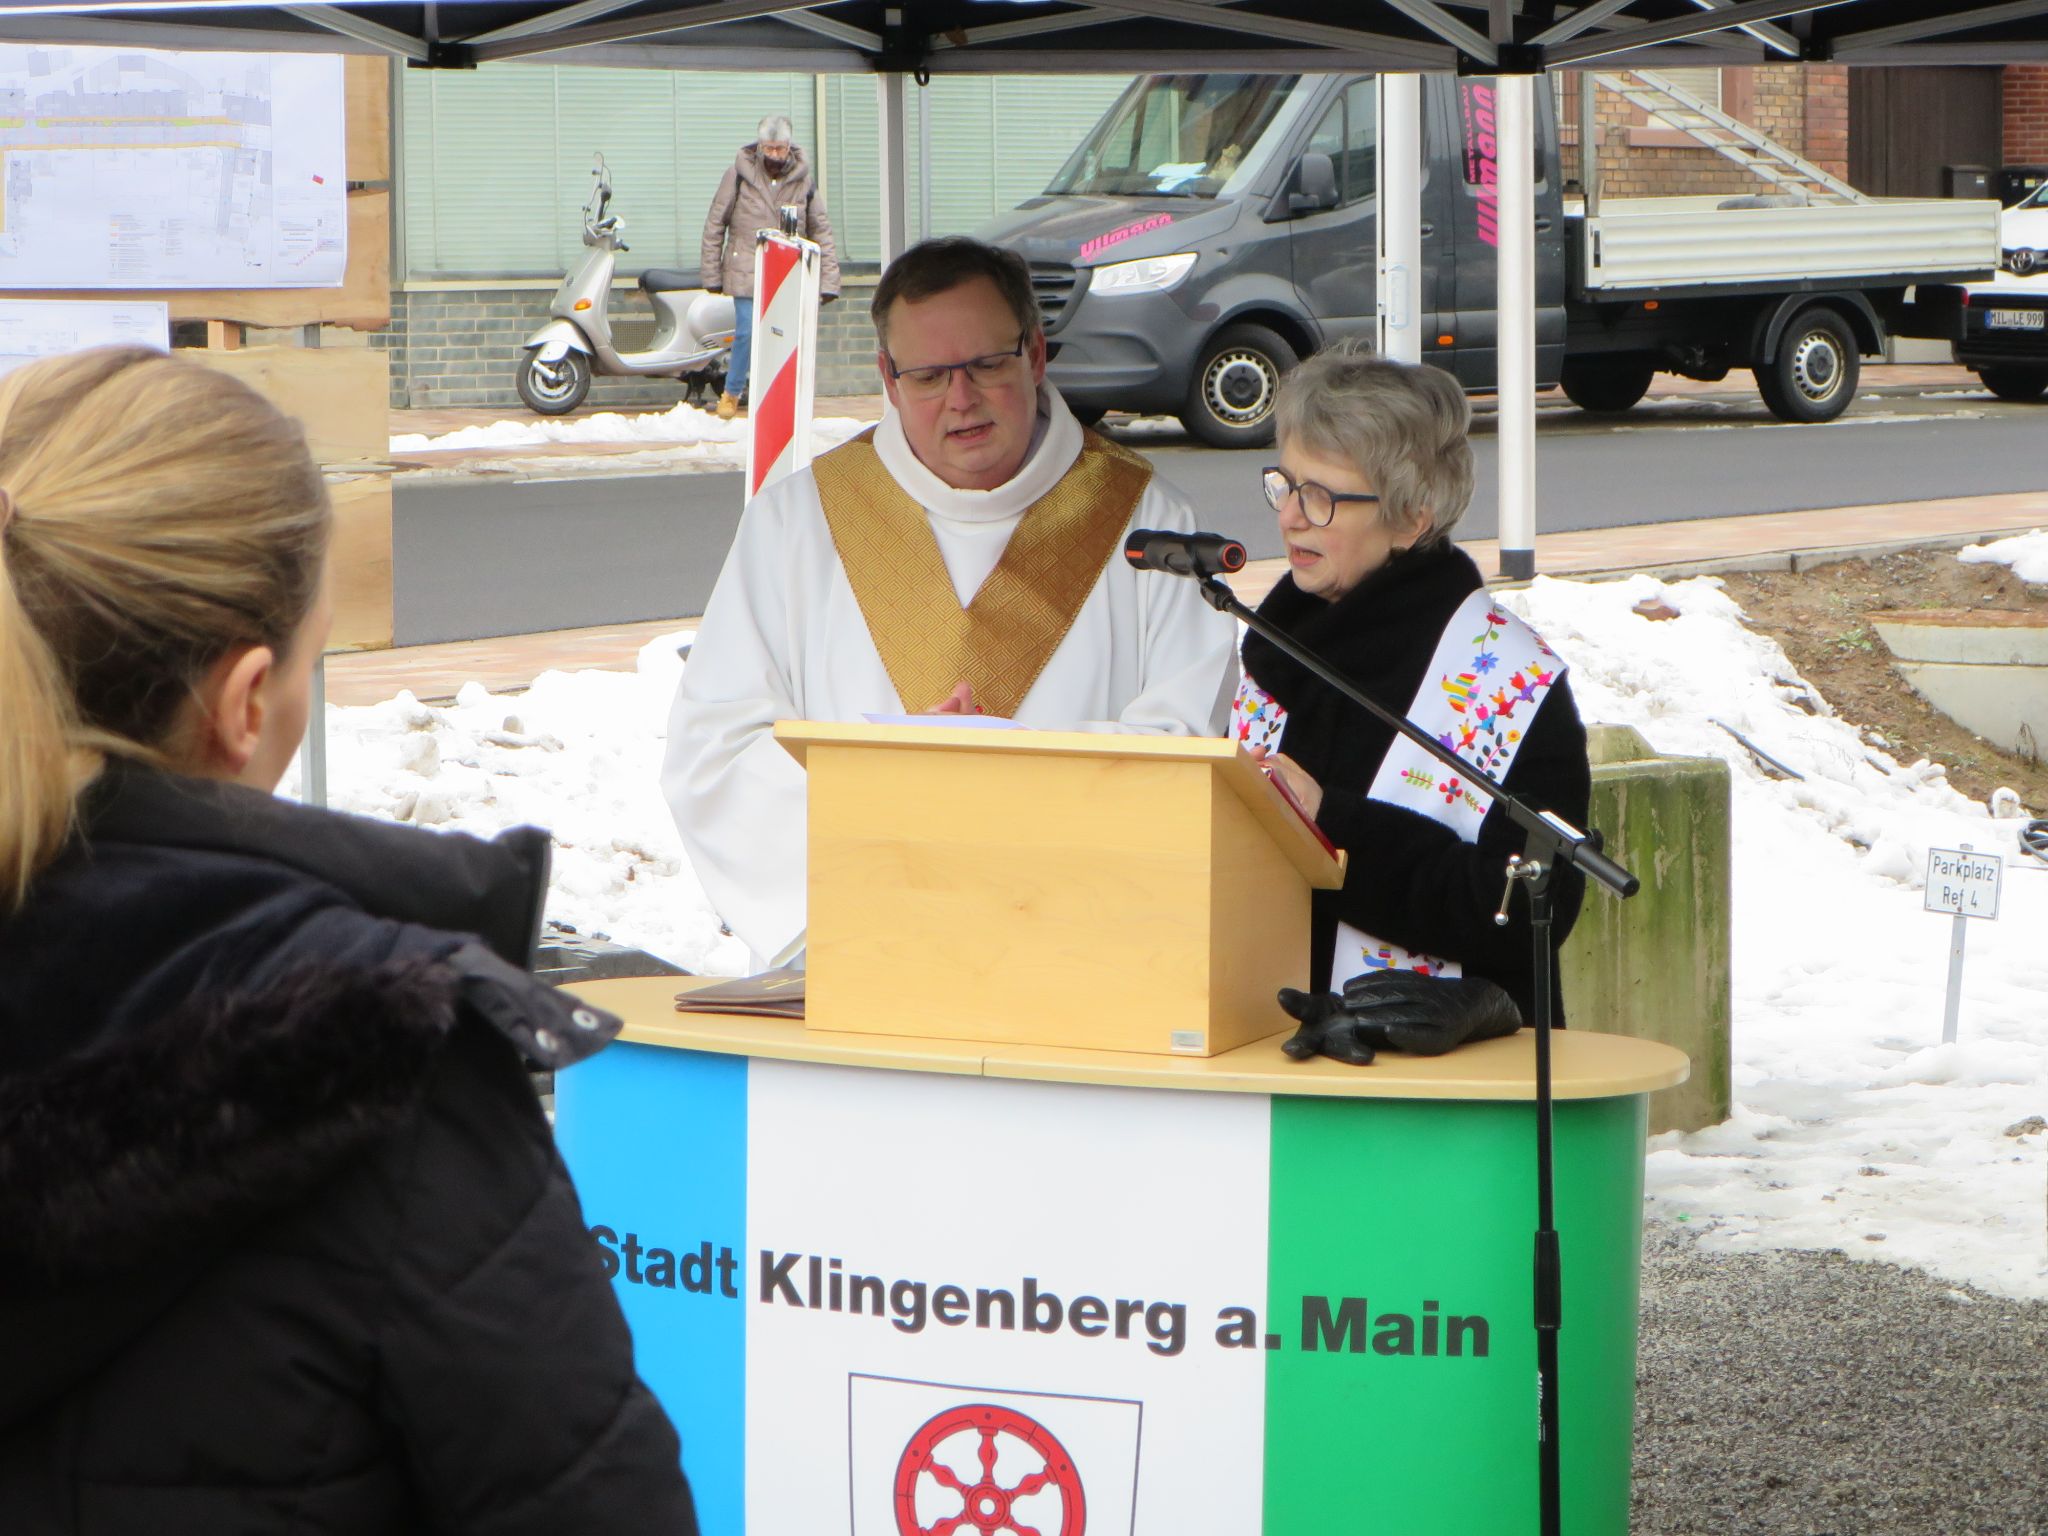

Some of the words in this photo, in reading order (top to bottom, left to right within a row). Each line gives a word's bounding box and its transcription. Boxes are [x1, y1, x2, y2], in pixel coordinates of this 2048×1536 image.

[1461, 84, 1477, 184] METALLBAU
[1991, 311, 2007, 325] MIL
[2013, 312, 2024, 326] LE
[2026, 312, 2043, 327] 999
[1933, 855, 1995, 883] Parkplatz
[1942, 886, 1964, 906] Ref
[1970, 890, 1978, 909] 4
[588, 1224, 738, 1300] Stadt
[758, 1250, 1188, 1356] Klingenberg
[1216, 1305, 1281, 1350] a.
[1299, 1295, 1490, 1359] Main
